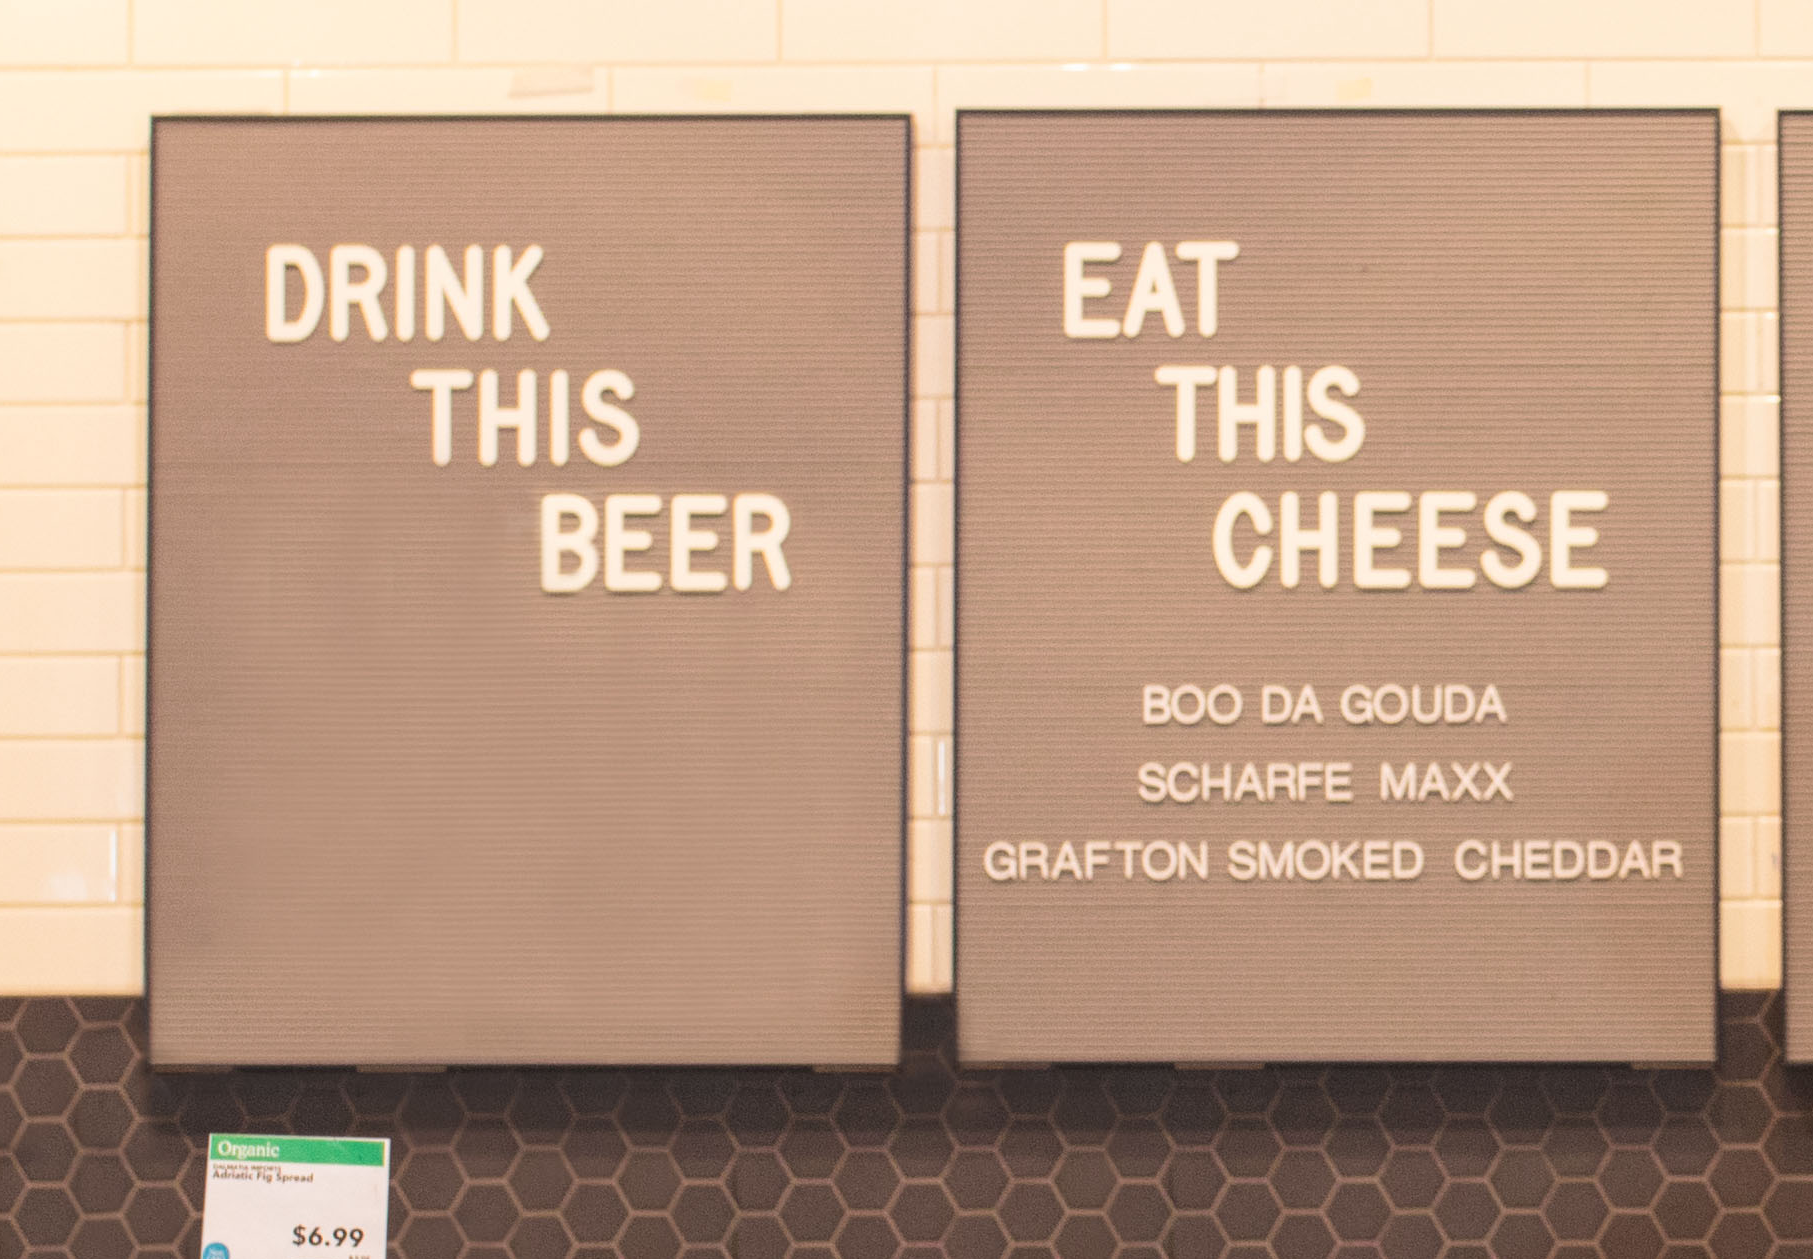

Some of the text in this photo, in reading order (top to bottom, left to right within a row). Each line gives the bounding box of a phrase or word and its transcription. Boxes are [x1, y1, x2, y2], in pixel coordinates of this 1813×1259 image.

[265, 243, 551, 342] DRINK
[1064, 240, 1240, 338] EAT
[410, 369, 640, 466] THIS
[1154, 364, 1365, 462] THIS
[540, 493, 791, 592] BEER
[1212, 490, 1610, 589] CHEESE
[1142, 684, 1508, 725] BOO DA GOUDA
[1138, 762, 1513, 802] SCHARFE MAXX
[984, 840, 1684, 880] GRAFTON SMOKED CHEDDAR
[213, 1170, 314, 1184] Adriatic Fig Spread
[218, 1140, 280, 1159] Organic
[292, 1224, 364, 1247] $6.99
